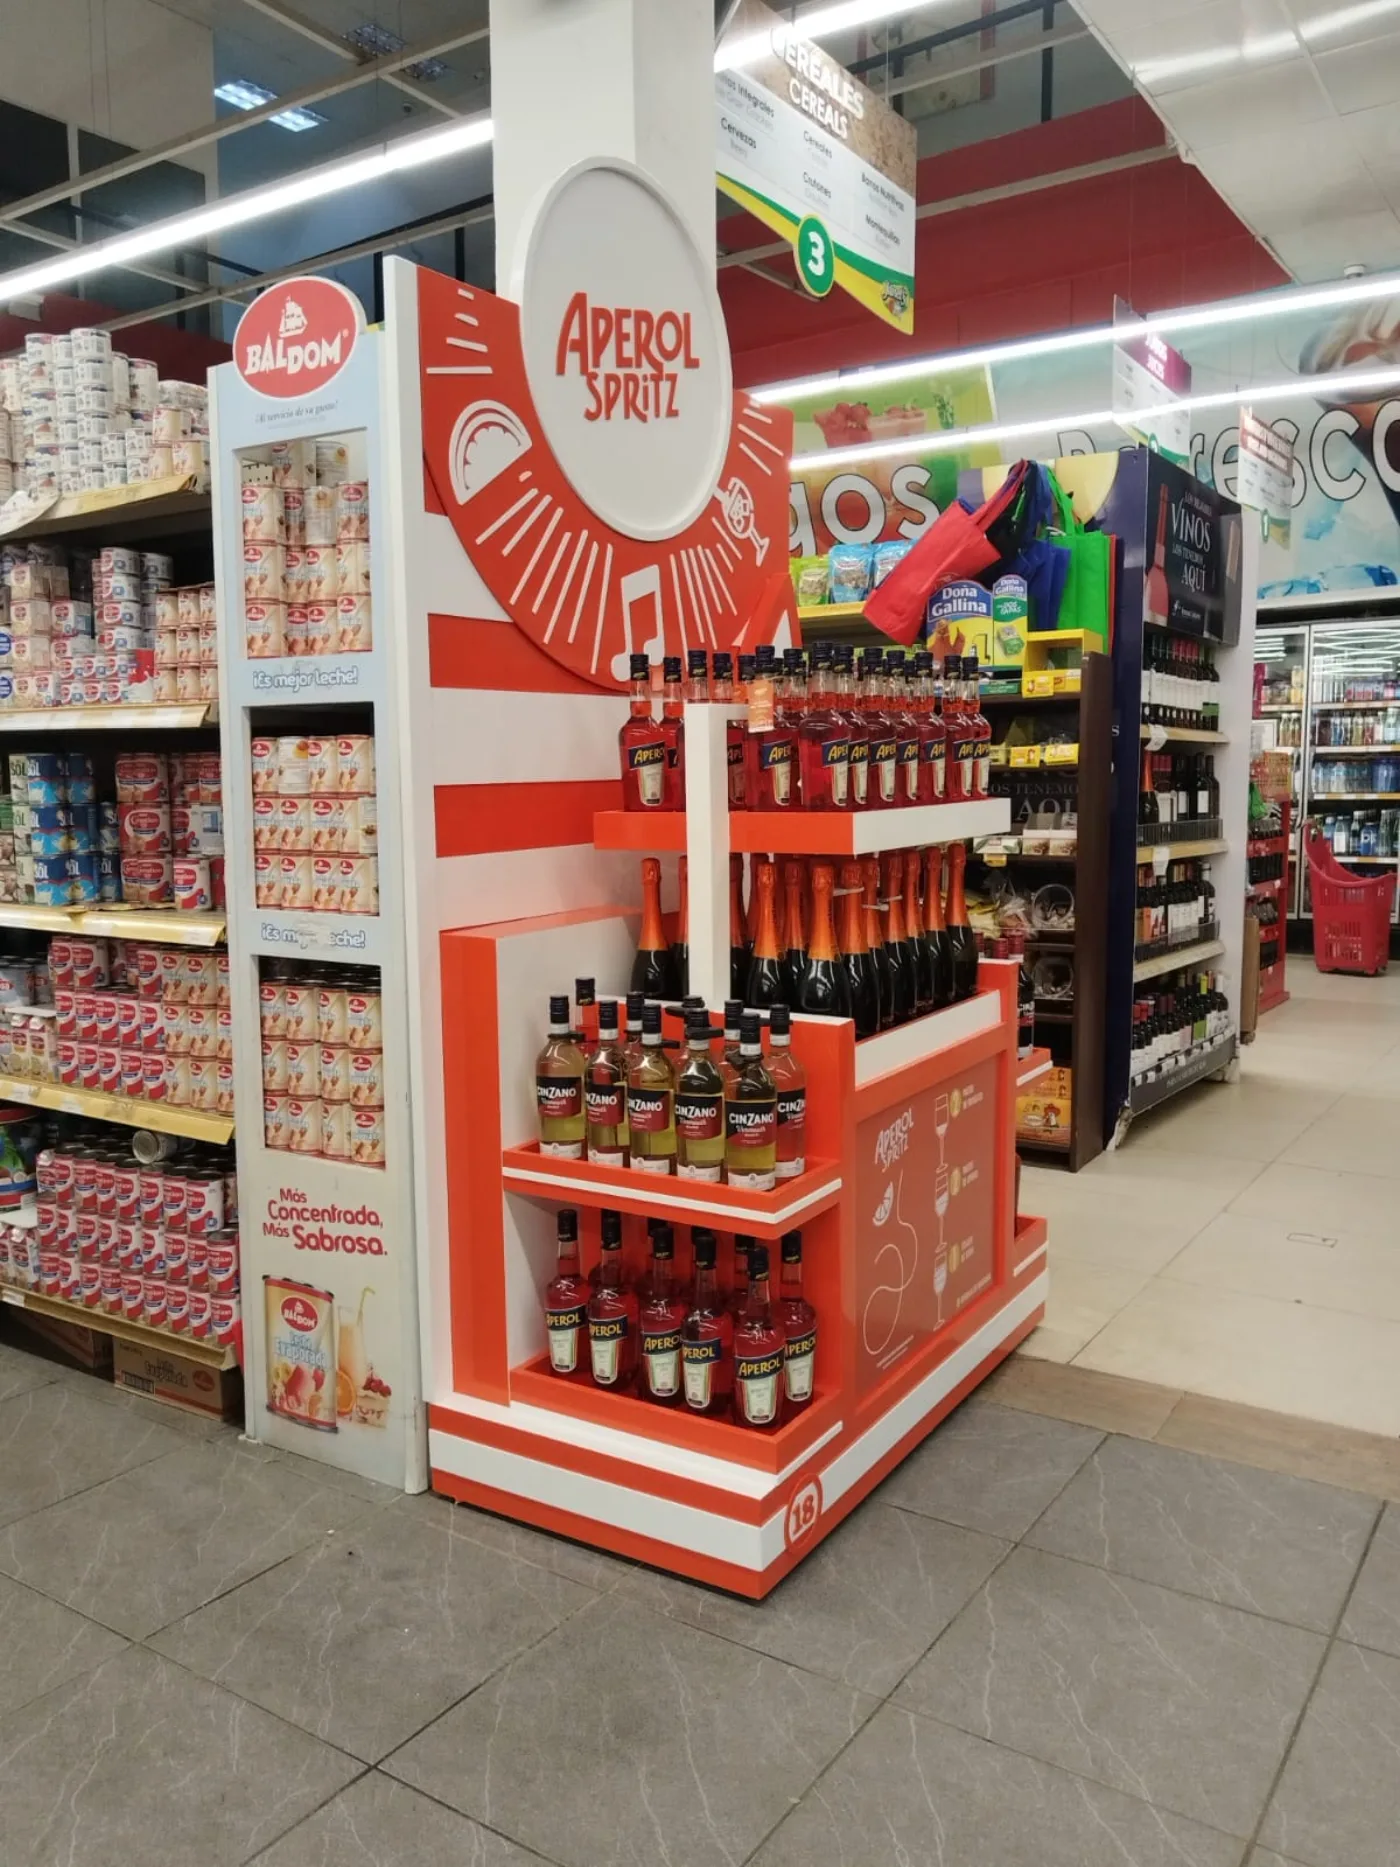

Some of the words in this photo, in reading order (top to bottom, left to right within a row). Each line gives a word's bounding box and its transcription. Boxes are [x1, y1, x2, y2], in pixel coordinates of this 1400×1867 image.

[789, 78, 848, 140] CEREALS
[720, 116, 757, 149] Cervezas
[803, 130, 832, 159] Cereales
[807, 231, 826, 277] 3
[556, 291, 700, 377] APEROL
[244, 331, 341, 376] BALDOM
[295, 407, 304, 417] de
[1171, 497, 1211, 553] VINOS
[942, 583, 978, 600] Doña
[1181, 563, 1207, 593] AQUÍ
[931, 597, 987, 617] Gallina
[274, 668, 314, 693] mejor
[314, 665, 359, 686] leche!
[327, 928, 366, 949] eche!
[675, 1103, 718, 1119] CINZANO
[728, 1111, 775, 1127] CINZANO
[875, 1107, 914, 1165] APEROL
[279, 1187, 308, 1204] Más
[267, 1199, 384, 1229] Concentrada,
[262, 1221, 290, 1238] Más
[292, 1224, 388, 1256] Sabrosa.
[283, 1307, 317, 1328] BALDOM
[644, 1334, 681, 1351] APERO
[738, 1357, 781, 1377] APEROL
[792, 1494, 814, 1537] 18
